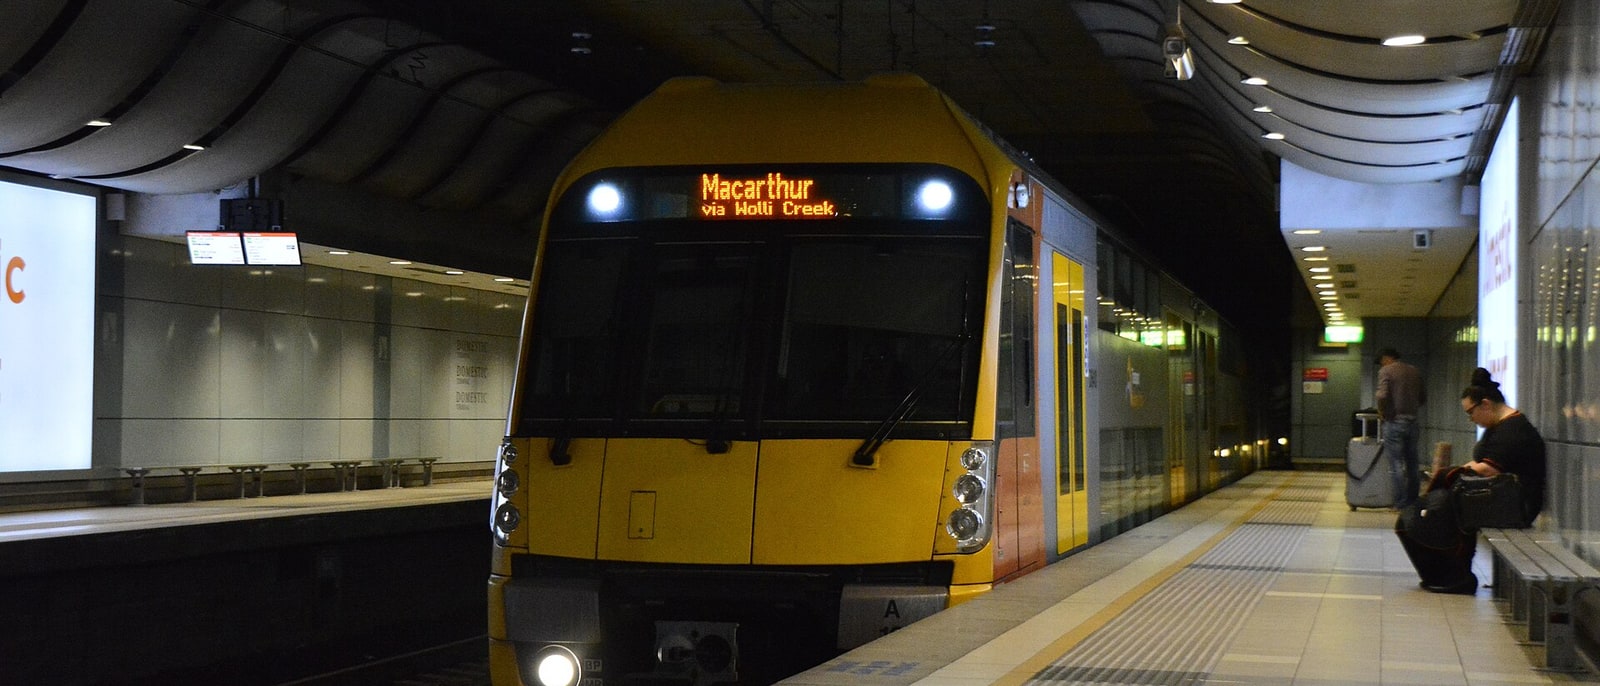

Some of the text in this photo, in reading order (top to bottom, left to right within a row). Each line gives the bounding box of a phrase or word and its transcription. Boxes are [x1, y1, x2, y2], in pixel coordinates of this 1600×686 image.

[701, 172, 814, 200] Macarthur
[701, 203, 726, 215] via
[734, 202, 774, 215] Wolli
[884, 599, 901, 618] A
